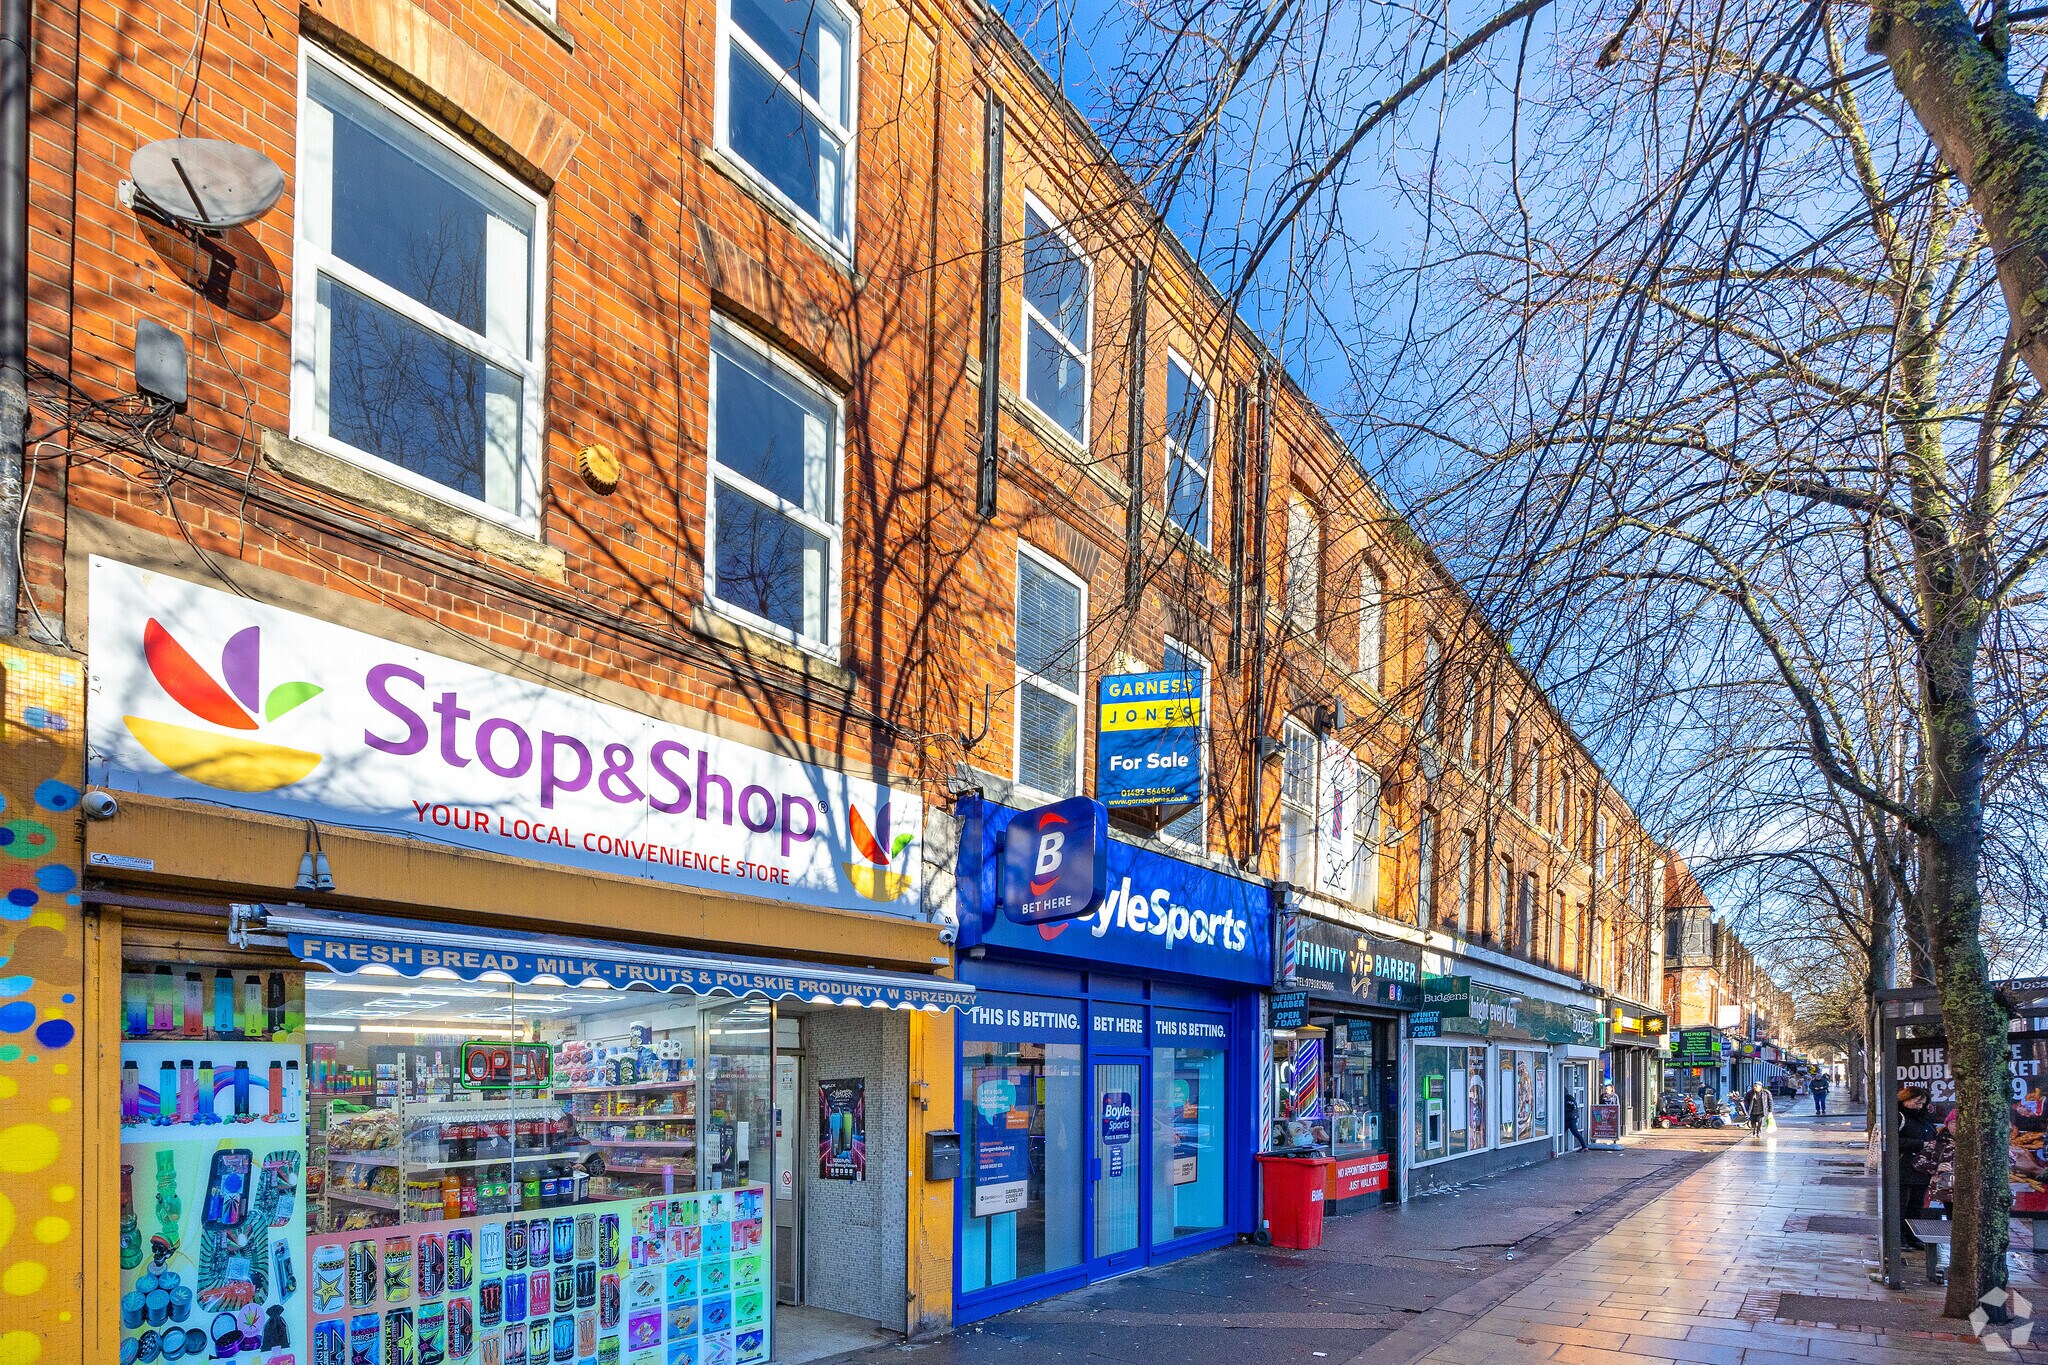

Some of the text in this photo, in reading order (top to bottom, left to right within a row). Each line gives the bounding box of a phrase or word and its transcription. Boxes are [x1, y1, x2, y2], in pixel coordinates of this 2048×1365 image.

[1109, 678, 1193, 697] GARNESS
[1109, 706, 1191, 724] JONES
[1110, 751, 1189, 771] For Sale
[412, 799, 791, 886] YOUR LOCAL CONVENIENCE STORE
[1034, 831, 1065, 876] B
[1022, 895, 1072, 915] BET HERE
[1078, 876, 1247, 952] yleSports
[303, 939, 413, 965] FRESH
[421, 950, 519, 971] BREAD
[537, 959, 599, 977] MILK
[615, 963, 694, 984] FRUITS
[698, 971, 713, 985] &
[716, 973, 794, 992] POLSKIE
[799, 980, 882, 999] PRODUKTY
[887, 988, 900, 1000] W
[904, 989, 977, 1005] SPRZEDAZY
[1375, 954, 1416, 984] BARBER
[1270, 992, 1307, 1002] INFINITY
[1272, 1000, 1304, 1009] BARBER
[1424, 992, 1468, 1003] Budgens
[972, 1007, 1081, 1030] THIS IS BETTING.
[1094, 1016, 1143, 1033] BET HERE
[1277, 1011, 1299, 1020] OPEN
[1281, 1019, 1301, 1027] DAYS
[1156, 1020, 1226, 1038] THIS IS BETTING.
[1911, 1048, 1944, 1064] THE
[468, 1050, 546, 1081] OPEN
[1896, 1064, 1953, 1081] DOUBL
[1105, 1103, 1130, 1120] Boyle
[1109, 1120, 1130, 1131] Sports
[1349, 1180, 1359, 1191] JUST
[1360, 1178, 1372, 1187] WALK
